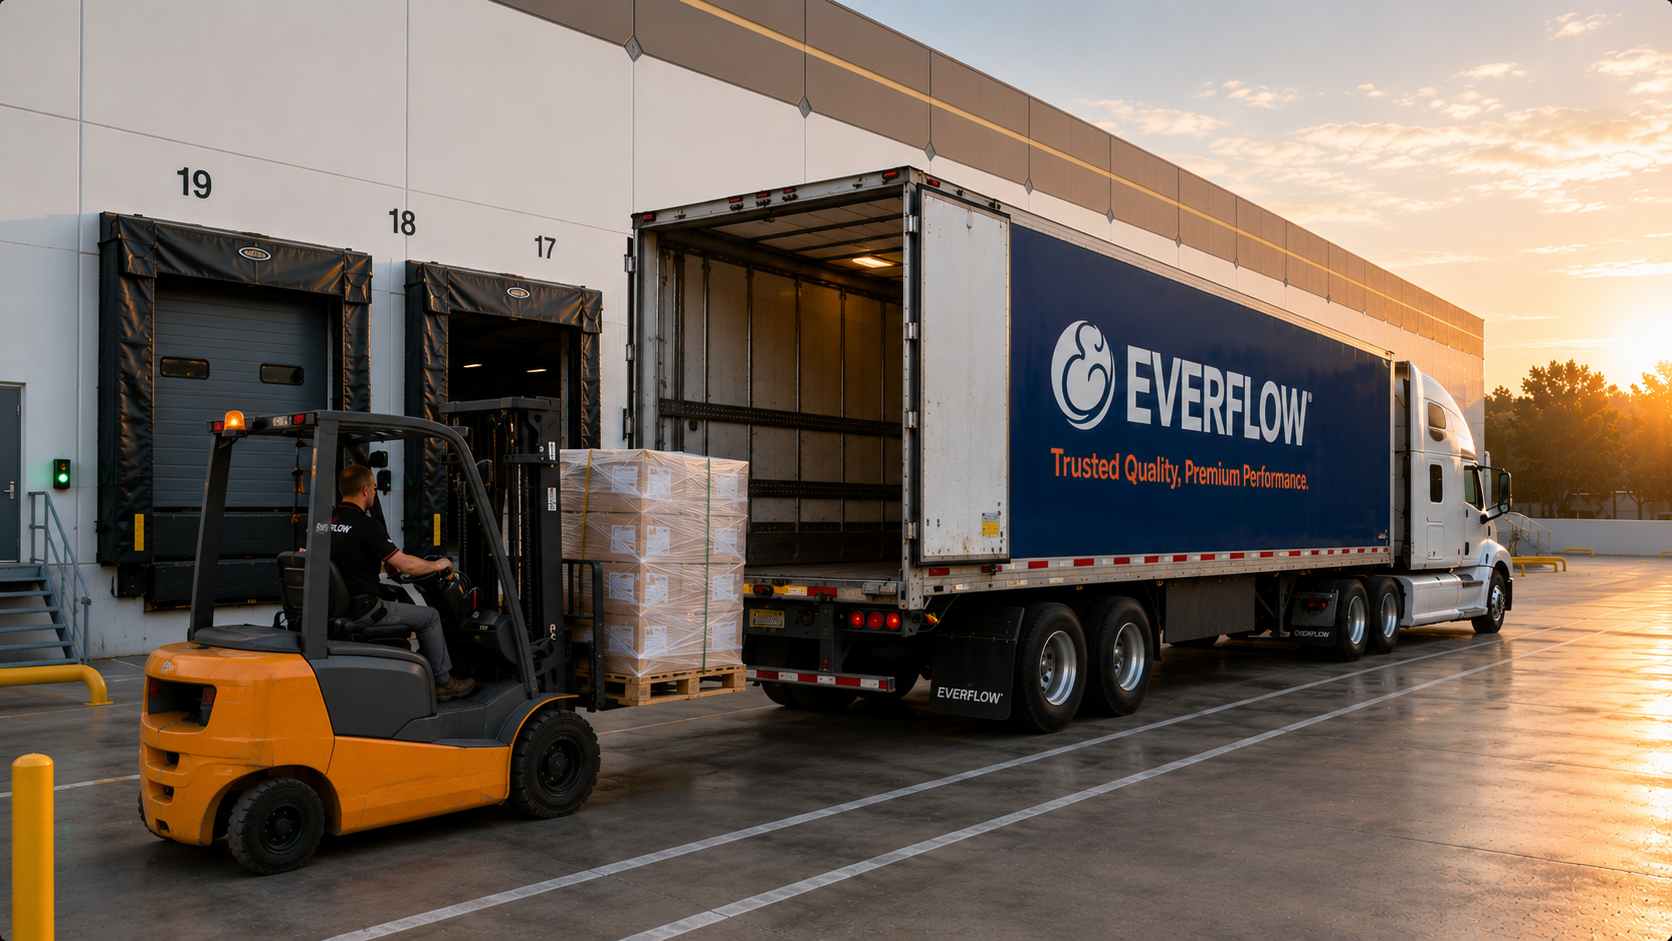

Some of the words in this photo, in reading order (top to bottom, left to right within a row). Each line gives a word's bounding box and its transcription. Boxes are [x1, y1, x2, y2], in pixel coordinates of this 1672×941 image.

[177, 166, 212, 199] 19
[389, 208, 416, 236] 18
[534, 235, 556, 259] 17
[1051, 447, 1119, 480] Trusted
[1125, 454, 1181, 489] Quality,
[1185, 459, 1240, 487] Premium
[1243, 464, 1309, 490] Performance.
